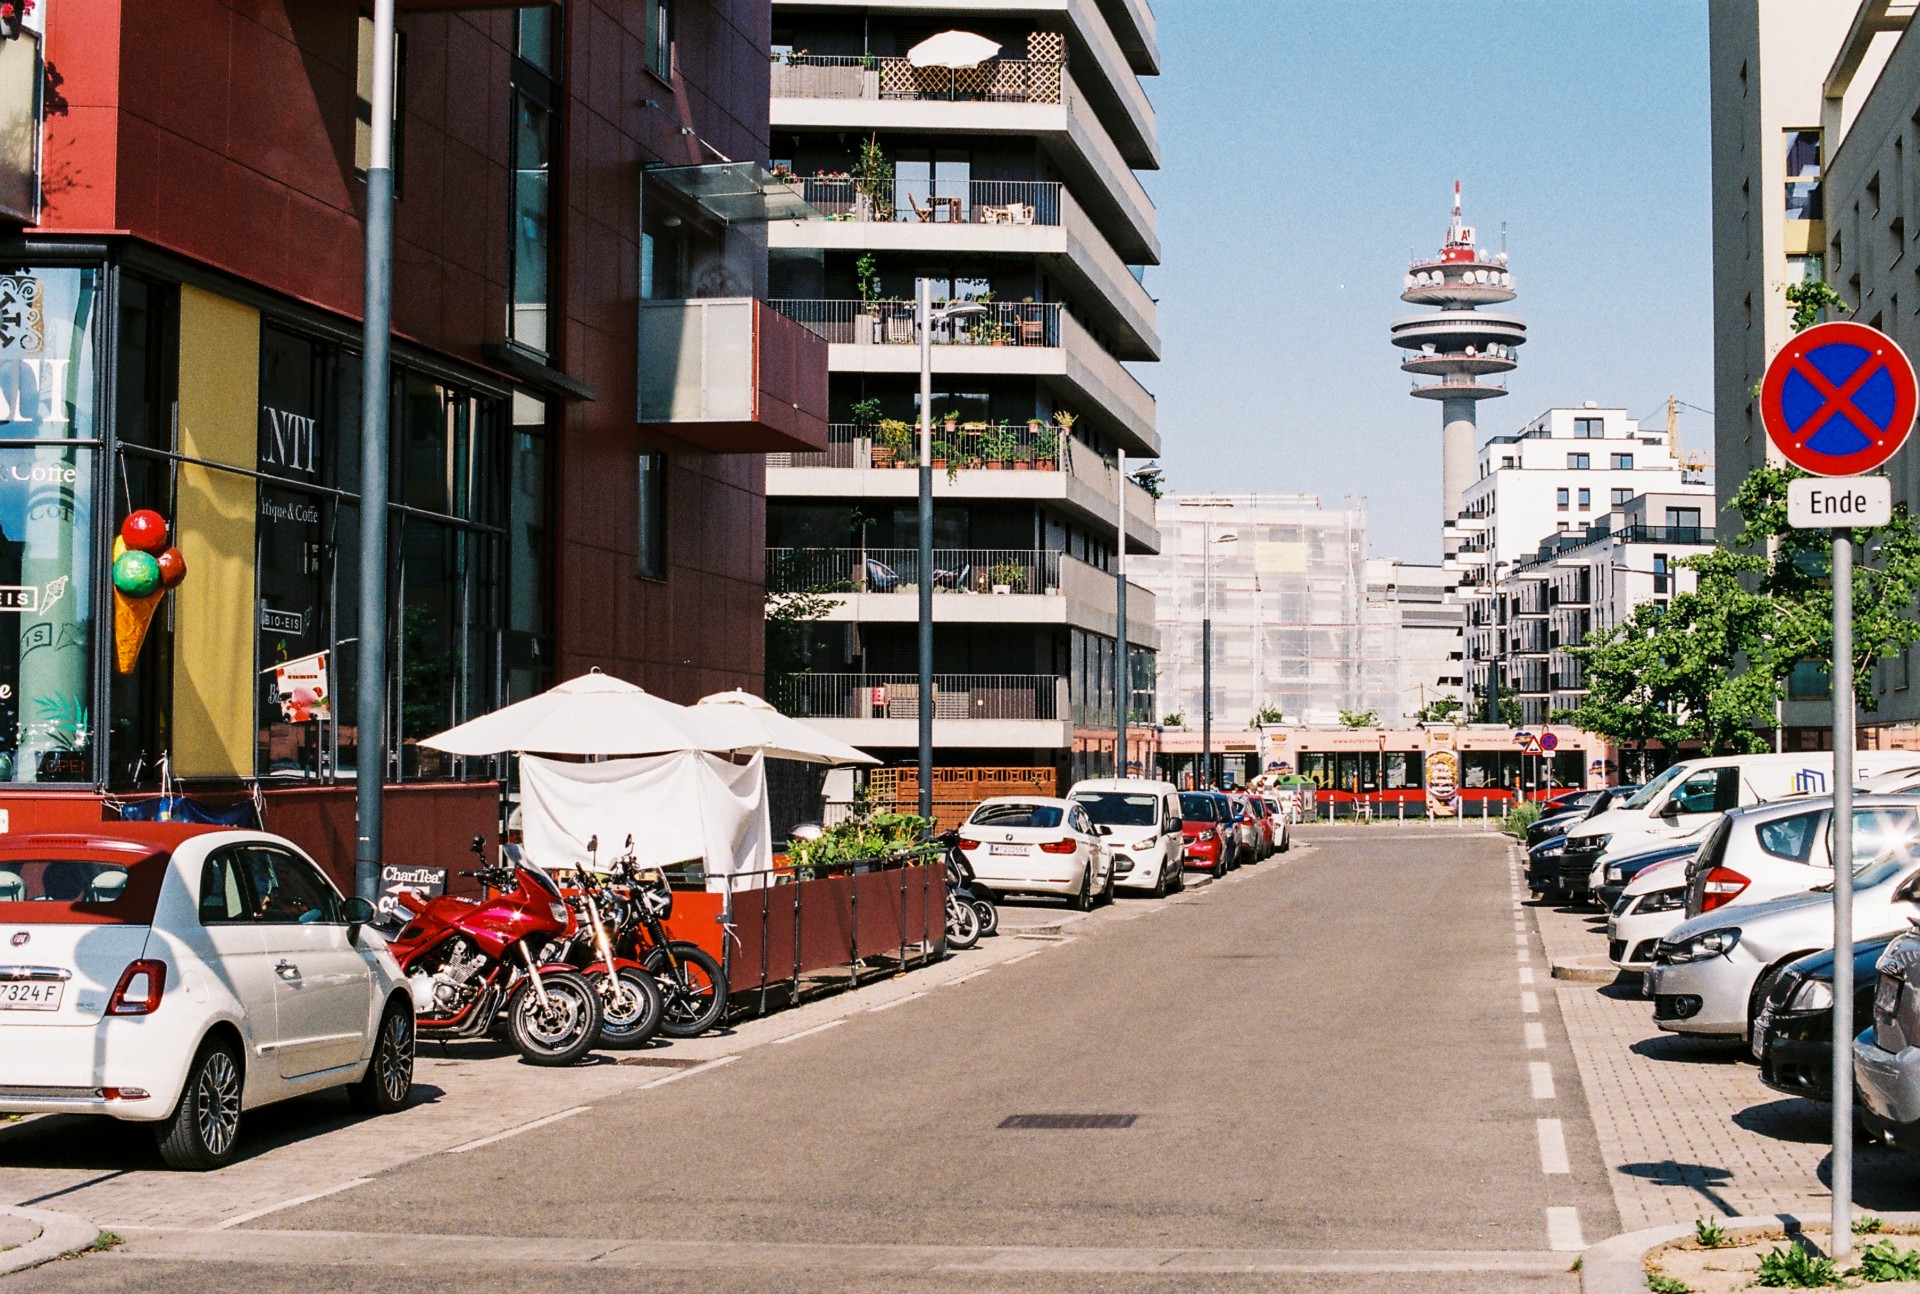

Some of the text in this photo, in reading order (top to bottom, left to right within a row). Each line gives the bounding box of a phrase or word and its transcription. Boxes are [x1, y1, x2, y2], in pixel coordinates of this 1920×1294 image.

[1810, 490, 1867, 514] Ende
[264, 615, 299, 630] BIO-EIS
[383, 866, 441, 884] ChariTea
